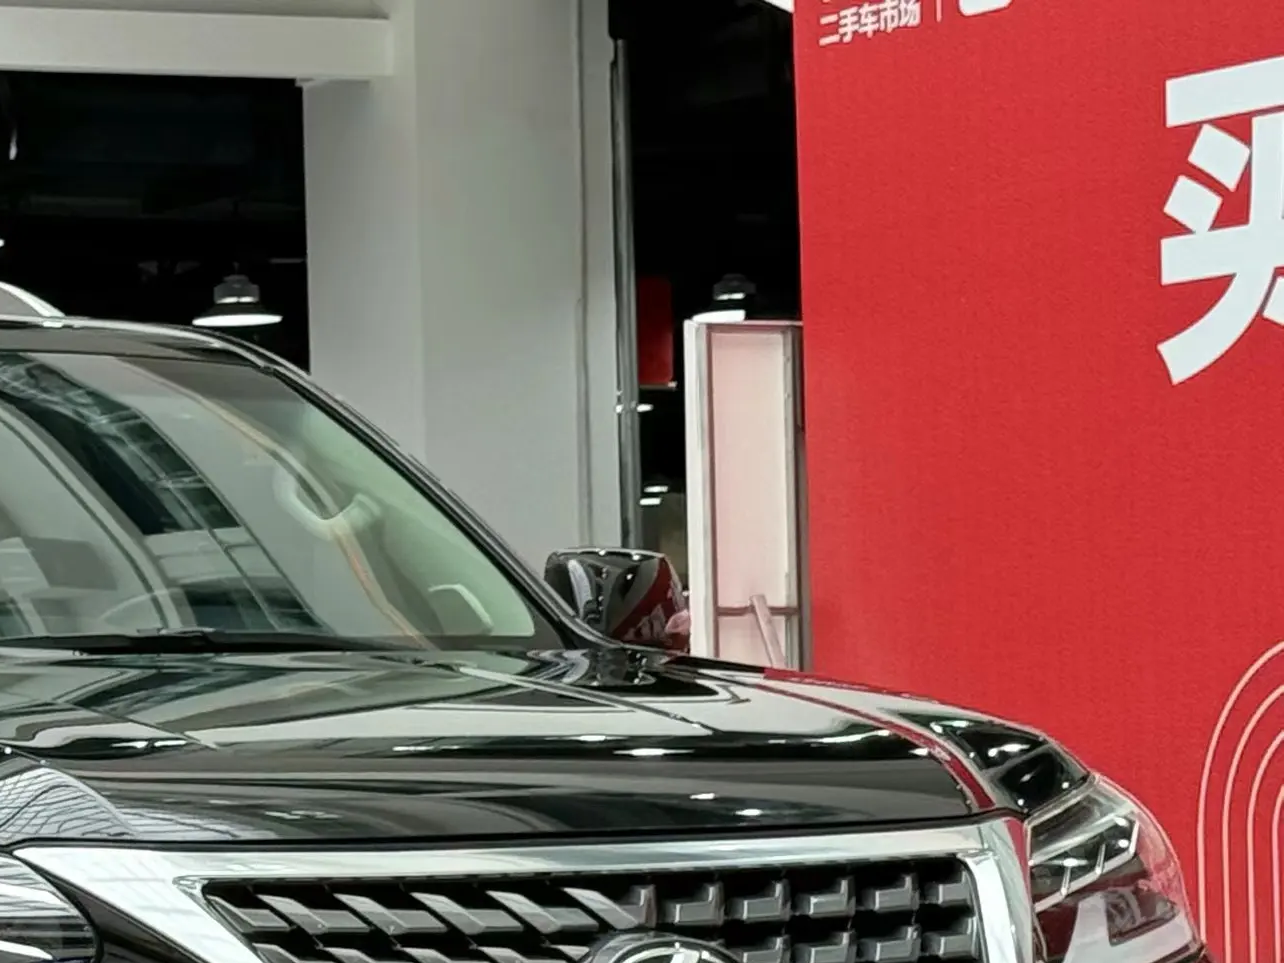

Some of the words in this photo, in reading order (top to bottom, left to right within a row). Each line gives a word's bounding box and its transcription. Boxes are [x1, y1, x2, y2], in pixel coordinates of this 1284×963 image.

[819, 0, 921, 46] 二手车市场
